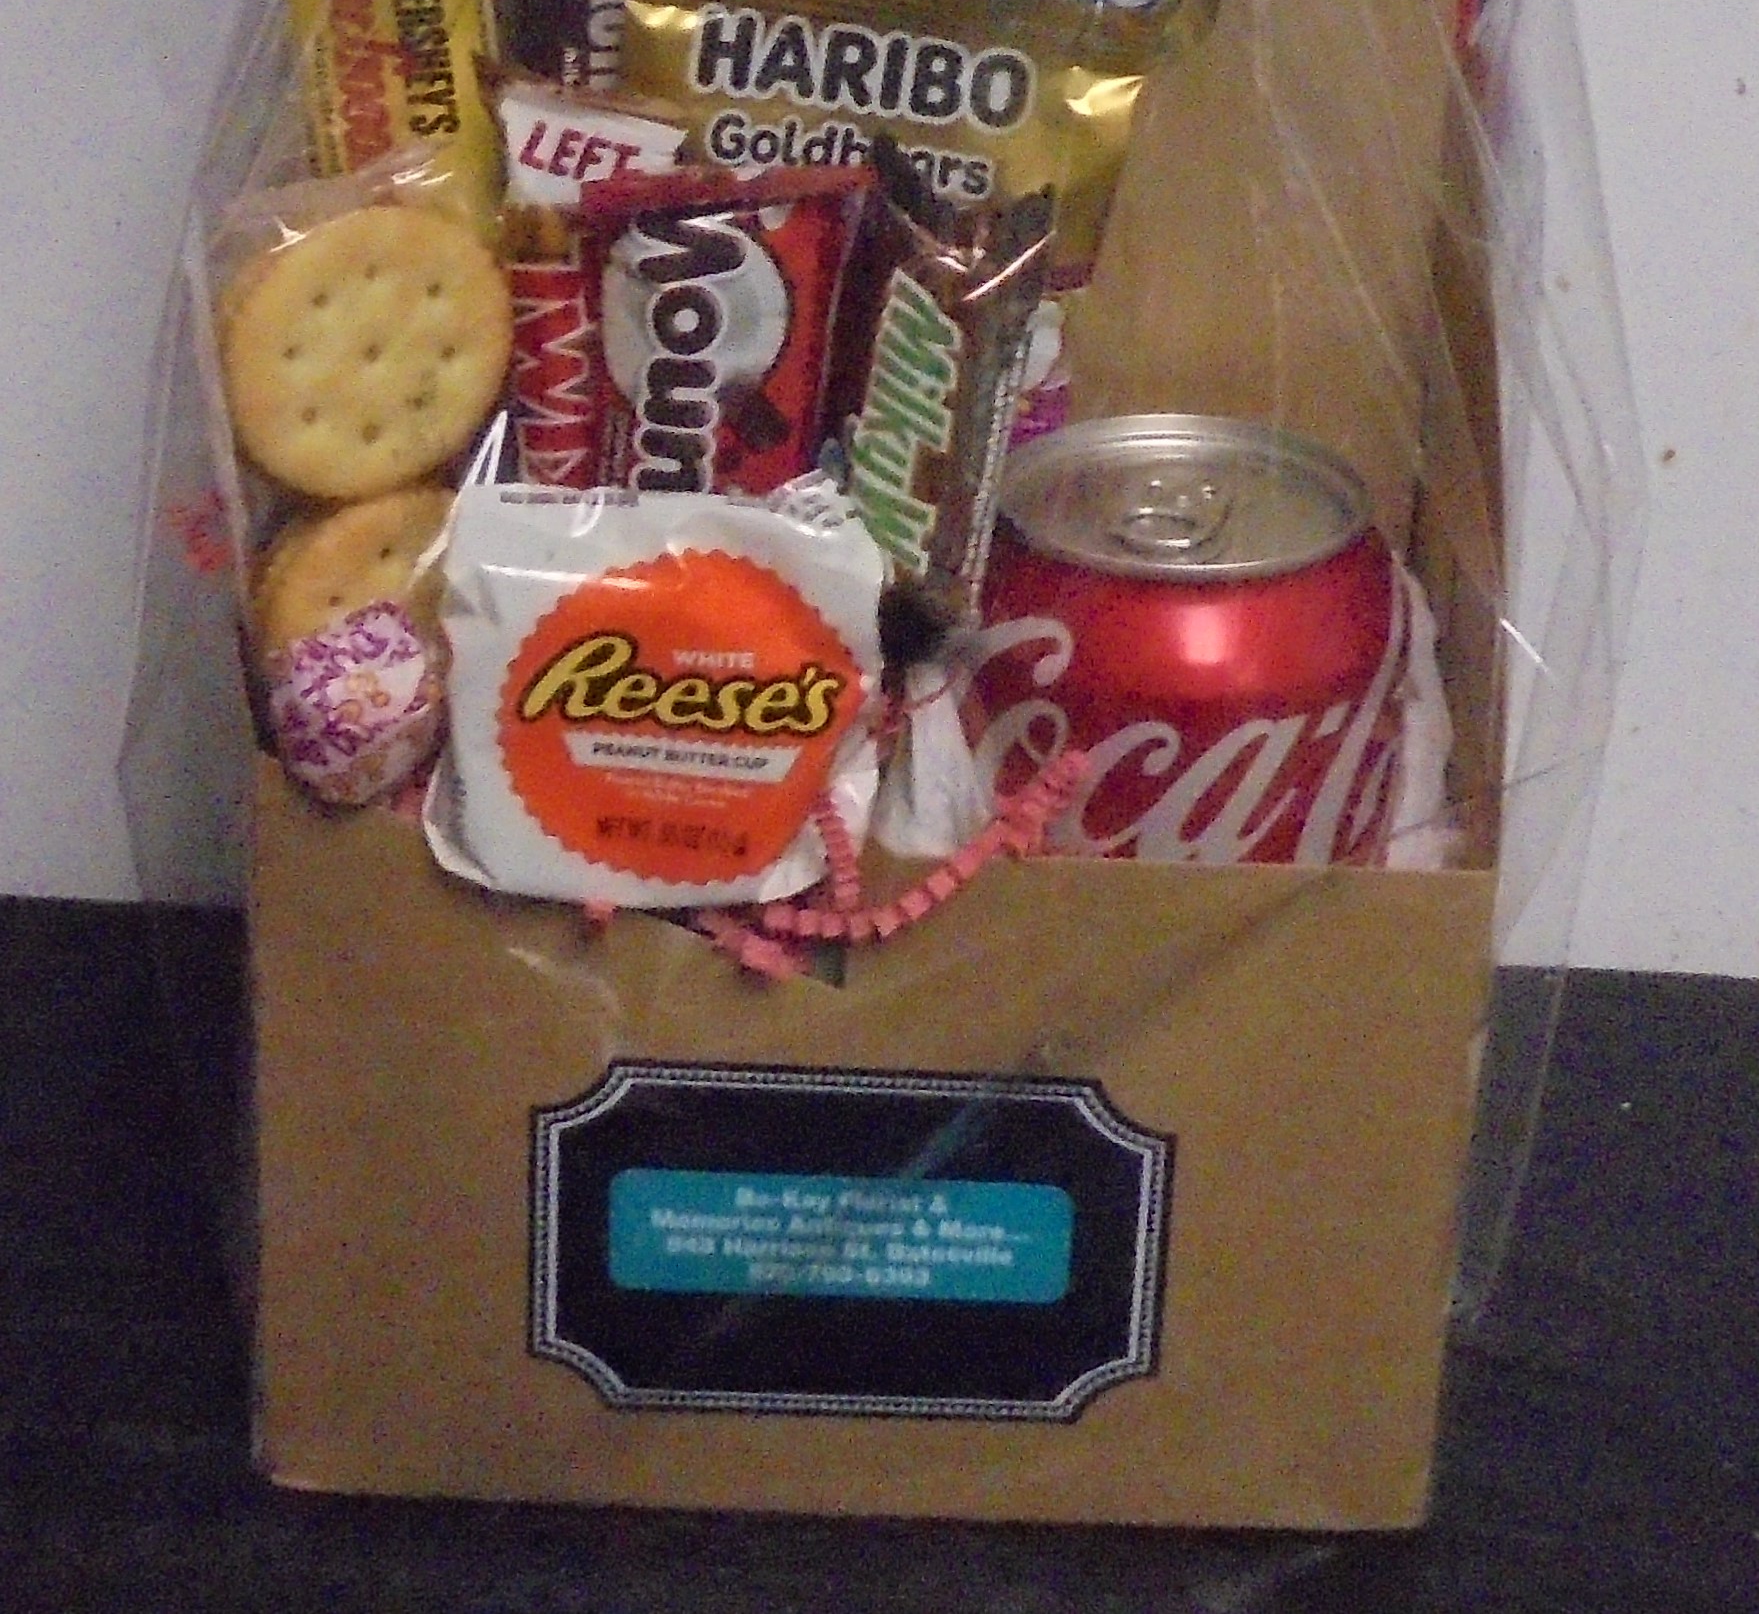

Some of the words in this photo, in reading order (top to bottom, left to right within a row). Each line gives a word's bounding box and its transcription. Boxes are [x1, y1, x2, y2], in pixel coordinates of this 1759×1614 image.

[692, 8, 1032, 131] HARIBO
[518, 118, 644, 180] LEFT
[709, 113, 991, 196] Goldbars
[636, 202, 748, 492] Moun
[519, 632, 844, 737] Reese's
[671, 648, 757, 670] WHITE
[591, 739, 661, 761] PEANUT
[664, 747, 732, 767] BUTTER
[733, 753, 770, 771] CUP
[911, 1218, 933, 1237] &
[929, 1193, 949, 1214] &
